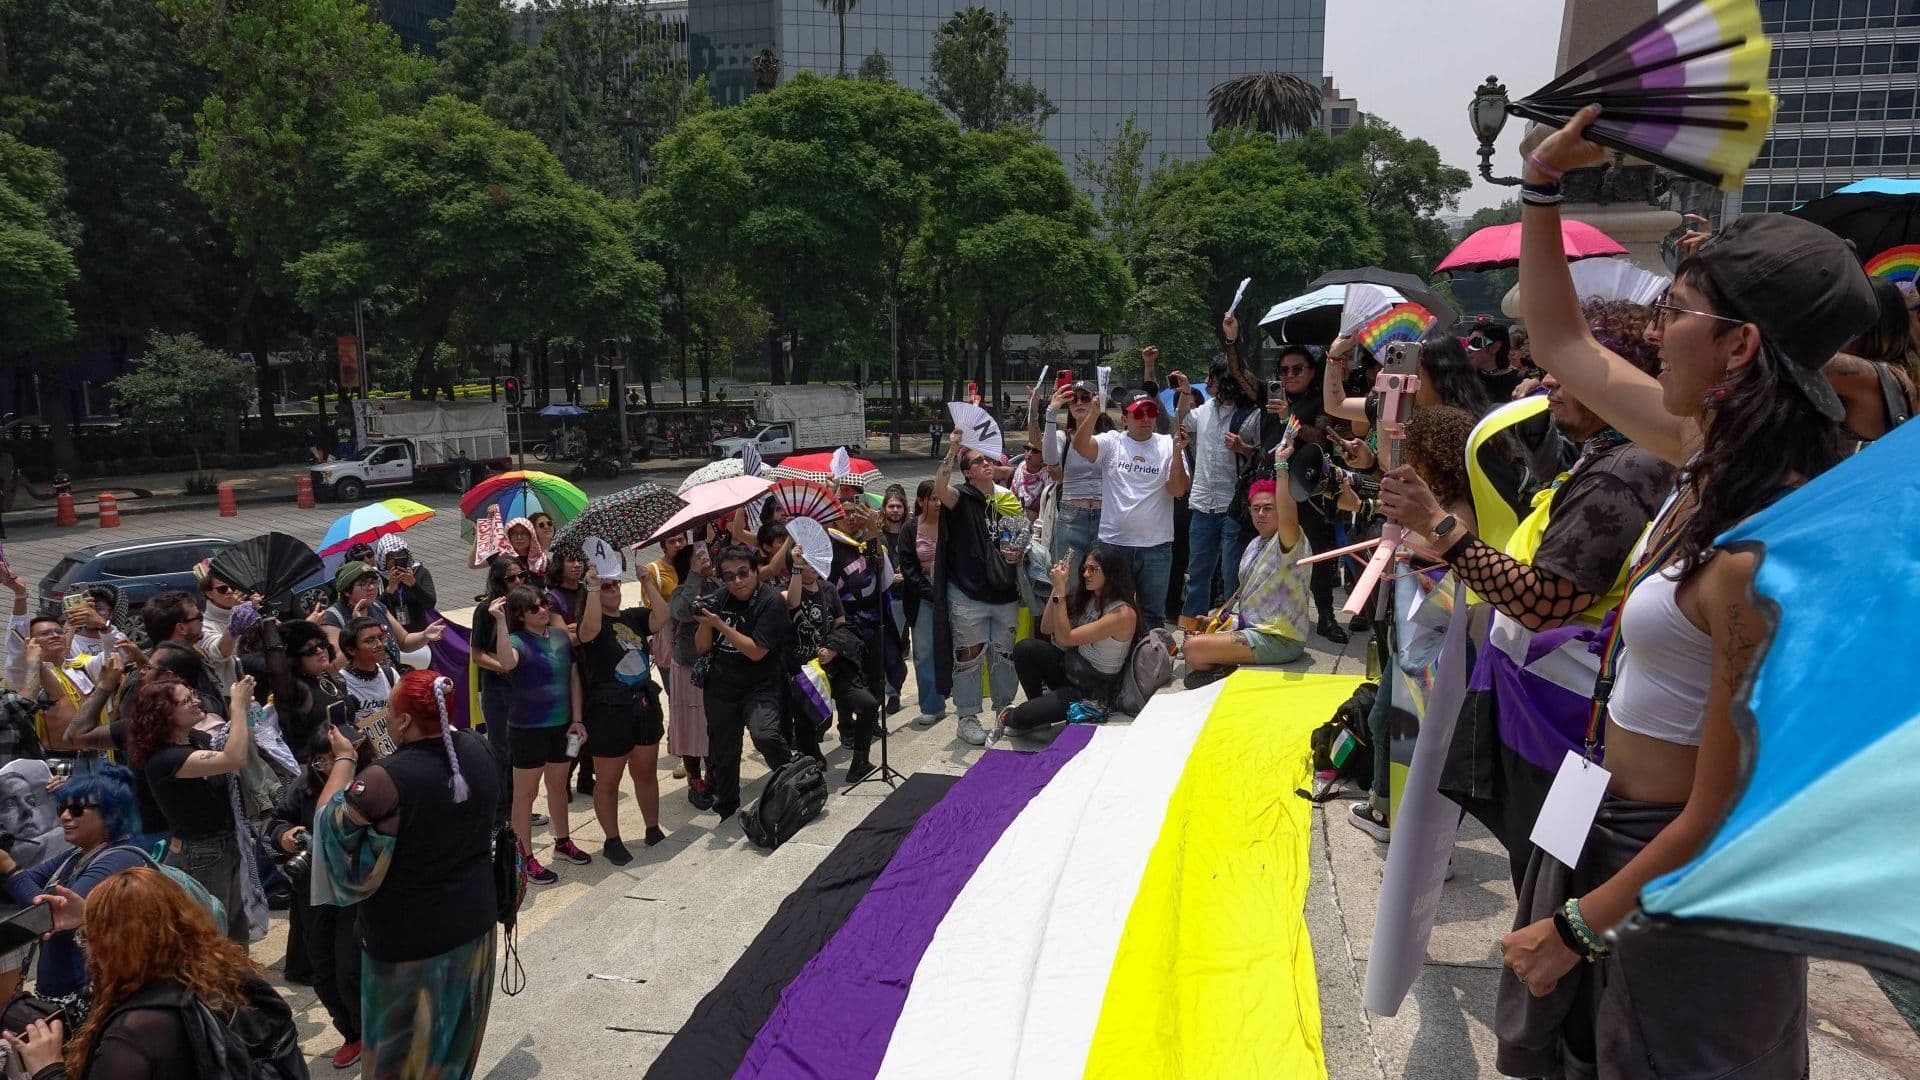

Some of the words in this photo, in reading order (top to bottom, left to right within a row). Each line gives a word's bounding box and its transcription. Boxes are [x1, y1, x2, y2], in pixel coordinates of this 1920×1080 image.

[1118, 462, 1132, 472] Hej
[1134, 466, 1160, 475] Pride!
[595, 540, 606, 560] A
